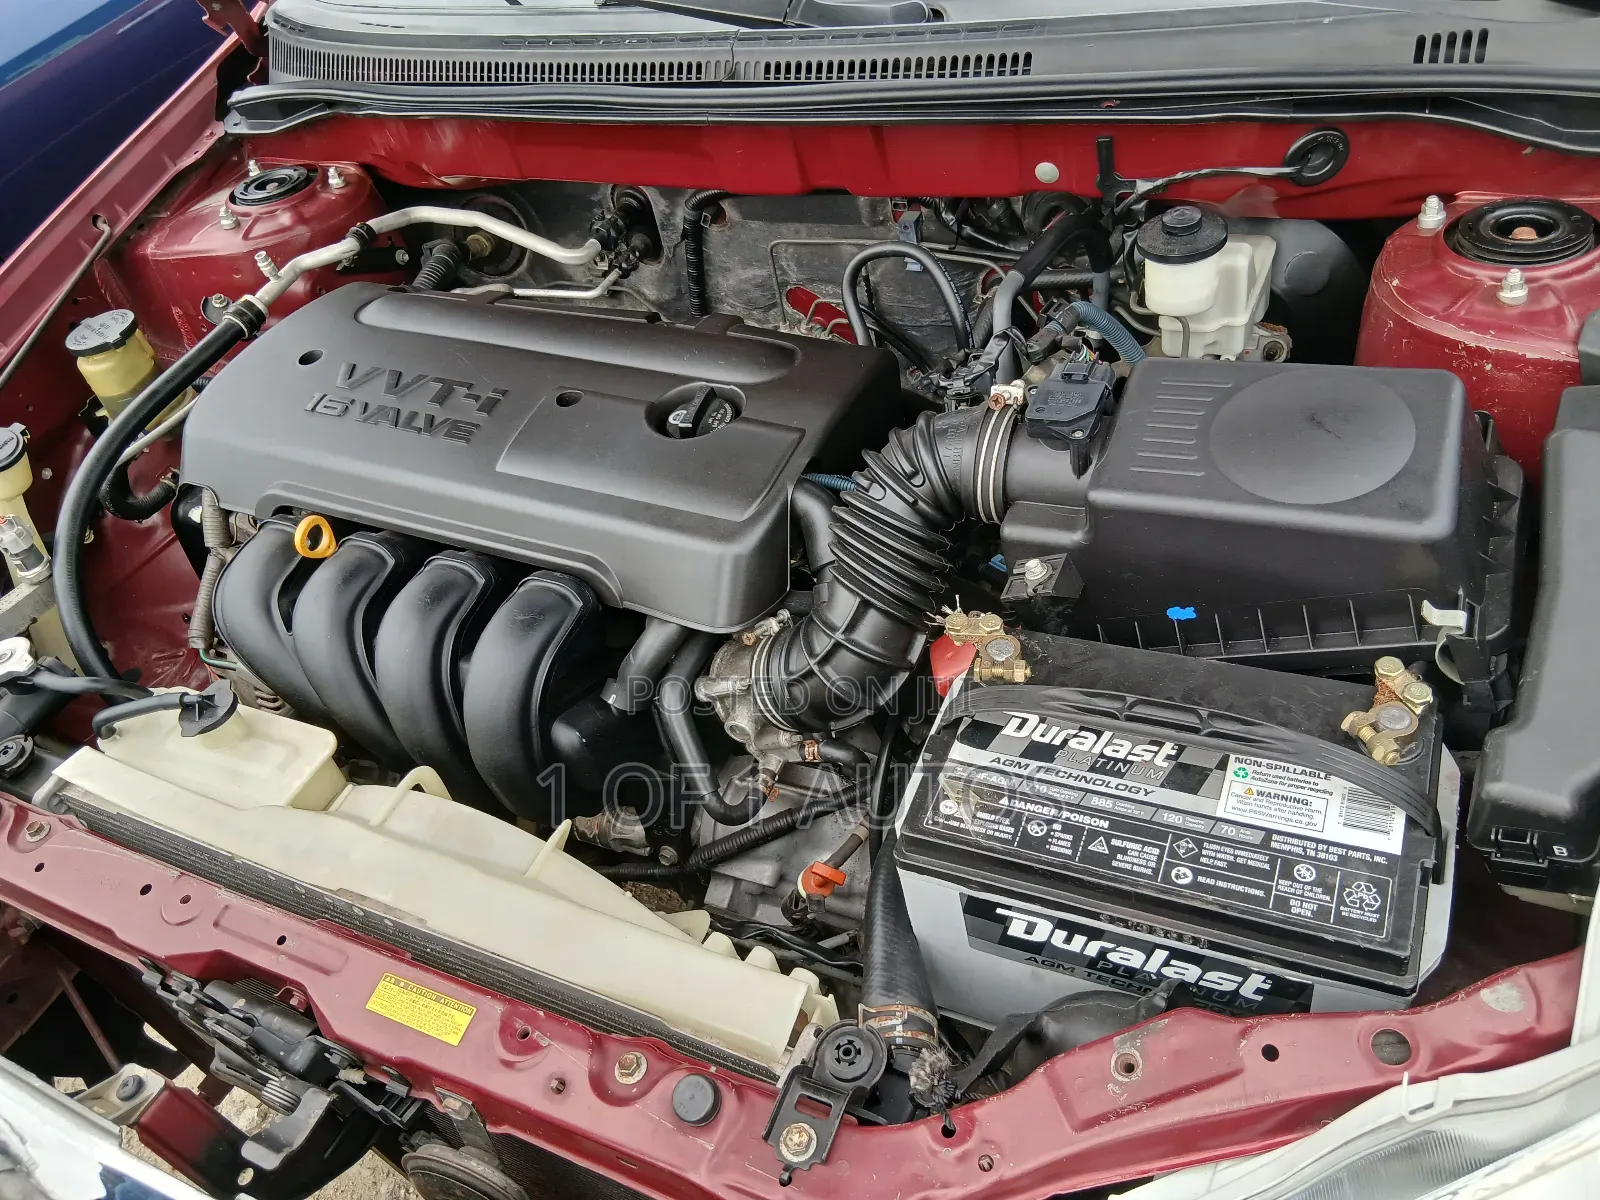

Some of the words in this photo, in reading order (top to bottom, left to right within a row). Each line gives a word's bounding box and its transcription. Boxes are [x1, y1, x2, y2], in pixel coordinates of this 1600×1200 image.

[304, 392, 355, 417] 16
[355, 400, 481, 444] VALVE
[1002, 710, 1178, 767] Duralast
[1054, 749, 1166, 780] PLATINUM
[1233, 756, 1332, 781] NON-SPILLABLE
[989, 756, 1031, 771] AGM
[1035, 765, 1156, 796] TECHNOLOGY
[1252, 769, 1271, 778] Return
[1286, 775, 1312, 786] batteries
[1250, 775, 1278, 785] AutoZone
[1287, 782, 1307, 791] proper
[1307, 785, 1334, 796] recycling
[1090, 796, 1114, 808] 885
[1230, 791, 1251, 801] Cancer
[1265, 798, 1304, 812] Reproductive
[1304, 807, 1323, 816] Harm.
[1256, 789, 1313, 807] WARNING:
[1009, 801, 1110, 828] DANGER/POISON
[1162, 812, 1183, 824] 120
[1236, 798, 1253, 807] Wash
[1254, 801, 1272, 811] hands
[1287, 808, 1315, 820] handling.
[1052, 823, 1062, 831] NO
[1055, 832, 1073, 840] SPARKS
[1220, 825, 1236, 836] 70
[1053, 838, 1071, 847] FLAMES
[1110, 838, 1142, 851] SULFURIC
[1143, 845, 1160, 855] ACID
[1270, 841, 1305, 855] MEMPHIS,
[1306, 849, 1316, 857] TN
[1316, 851, 1338, 862] 38103
[1271, 833, 1317, 849] DISTRIBUTED
[1317, 843, 1328, 851] BY
[1328, 846, 1347, 856] BEST
[1347, 850, 1372, 862] PARTS,
[1373, 855, 1388, 864] INC.
[1552, 845, 1568, 856] B
[1116, 854, 1147, 866] BLINDNESS
[1127, 849, 1139, 857] CAN
[1139, 852, 1158, 861] CAUSE
[1201, 849, 1216, 858] WITH
[1236, 856, 1247, 864] GET
[1247, 859, 1271, 870] MEDICAL
[1203, 842, 1220, 851] FLUSH
[1220, 846, 1234, 855] EYES
[1234, 848, 1269, 862] IMMEDIATELY
[1111, 860, 1133, 870] SEVERE
[1133, 866, 1153, 875] BURNS.
[1197, 876, 1215, 886] READ
[1216, 879, 1266, 897] INSTRUCTIONS.
[1277, 885, 1295, 895] REACH
[1278, 879, 1292, 888] KEEP
[1292, 882, 1304, 890] OUT
[1312, 886, 1323, 894] THE
[1289, 898, 1302, 907] DO
[1302, 901, 1318, 911] NOT
[1290, 906, 1314, 918] OPEN.
[1340, 905, 1364, 915] BATTERY
[1364, 910, 1380, 919] MUST
[995, 907, 1272, 1002] Duralast
[1023, 955, 1075, 974] AGM
[408, 985, 437, 1001] CAUTION
[440, 995, 473, 1015] ATTENTION
